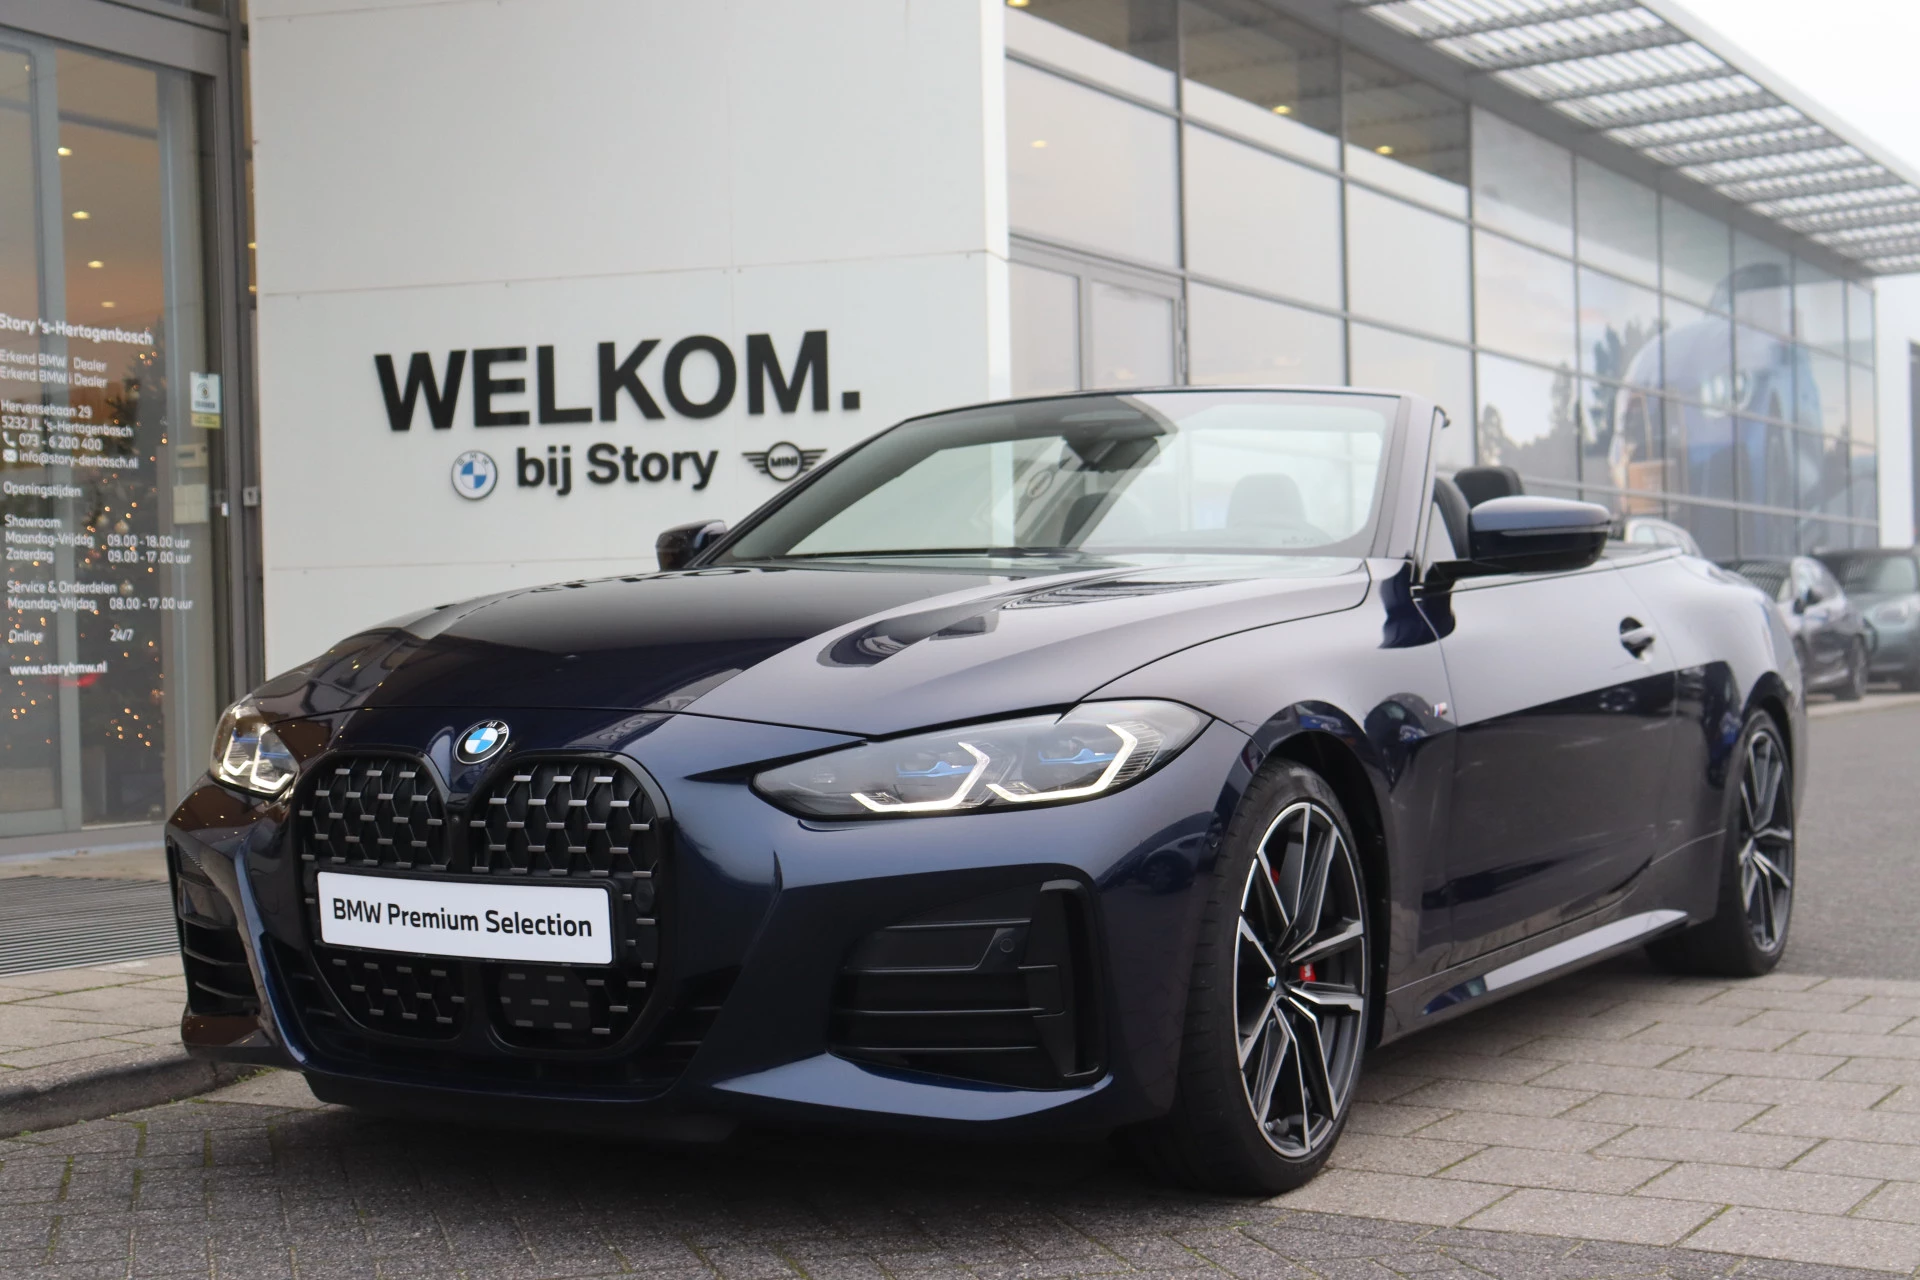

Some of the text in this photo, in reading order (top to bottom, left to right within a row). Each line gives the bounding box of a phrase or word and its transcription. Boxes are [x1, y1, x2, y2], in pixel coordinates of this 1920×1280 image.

[0, 312, 154, 345] Story 's-Hertogenbosch
[0, 348, 108, 373] Erkend BMW Dealer
[0, 365, 37, 382] Erkend
[39, 369, 67, 385] BMW
[74, 372, 108, 389] Dealer
[374, 329, 861, 432] WELKOM.
[0, 400, 93, 419] Hervensebaan 29
[1, 414, 134, 437] 5232 JL 's-Hertogenbosch
[18, 432, 40, 448] 073
[48, 435, 56, 449] 6
[58, 436, 80, 450] 200
[81, 437, 103, 452] 400
[19, 450, 139, 469] info@story-denbosch.nl
[516, 442, 719, 496] bij Story
[769, 455, 799, 468] MINI
[3, 481, 82, 498] Openingstijden
[4, 514, 62, 528] Showroom
[5, 531, 95, 547] Maandag-Vrijdag
[107, 533, 137, 547] 09.00
[145, 534, 173, 548] 18.00
[174, 538, 191, 549] uur
[6, 548, 54, 564] Zaterdag
[107, 550, 138, 563] 09.00
[147, 550, 174, 564] 17.00
[175, 553, 192, 564] uur
[7, 580, 118, 594] Service & Onderdelen
[7, 597, 97, 611] Maandag-Vrijdag
[109, 597, 141, 610] 08.00
[148, 597, 175, 610] 17.00
[176, 600, 193, 610] uur
[8, 628, 134, 644] Online 24/7
[10, 661, 108, 677] www.storybmw.nl
[332, 897, 593, 937] BMW Premium Selection
